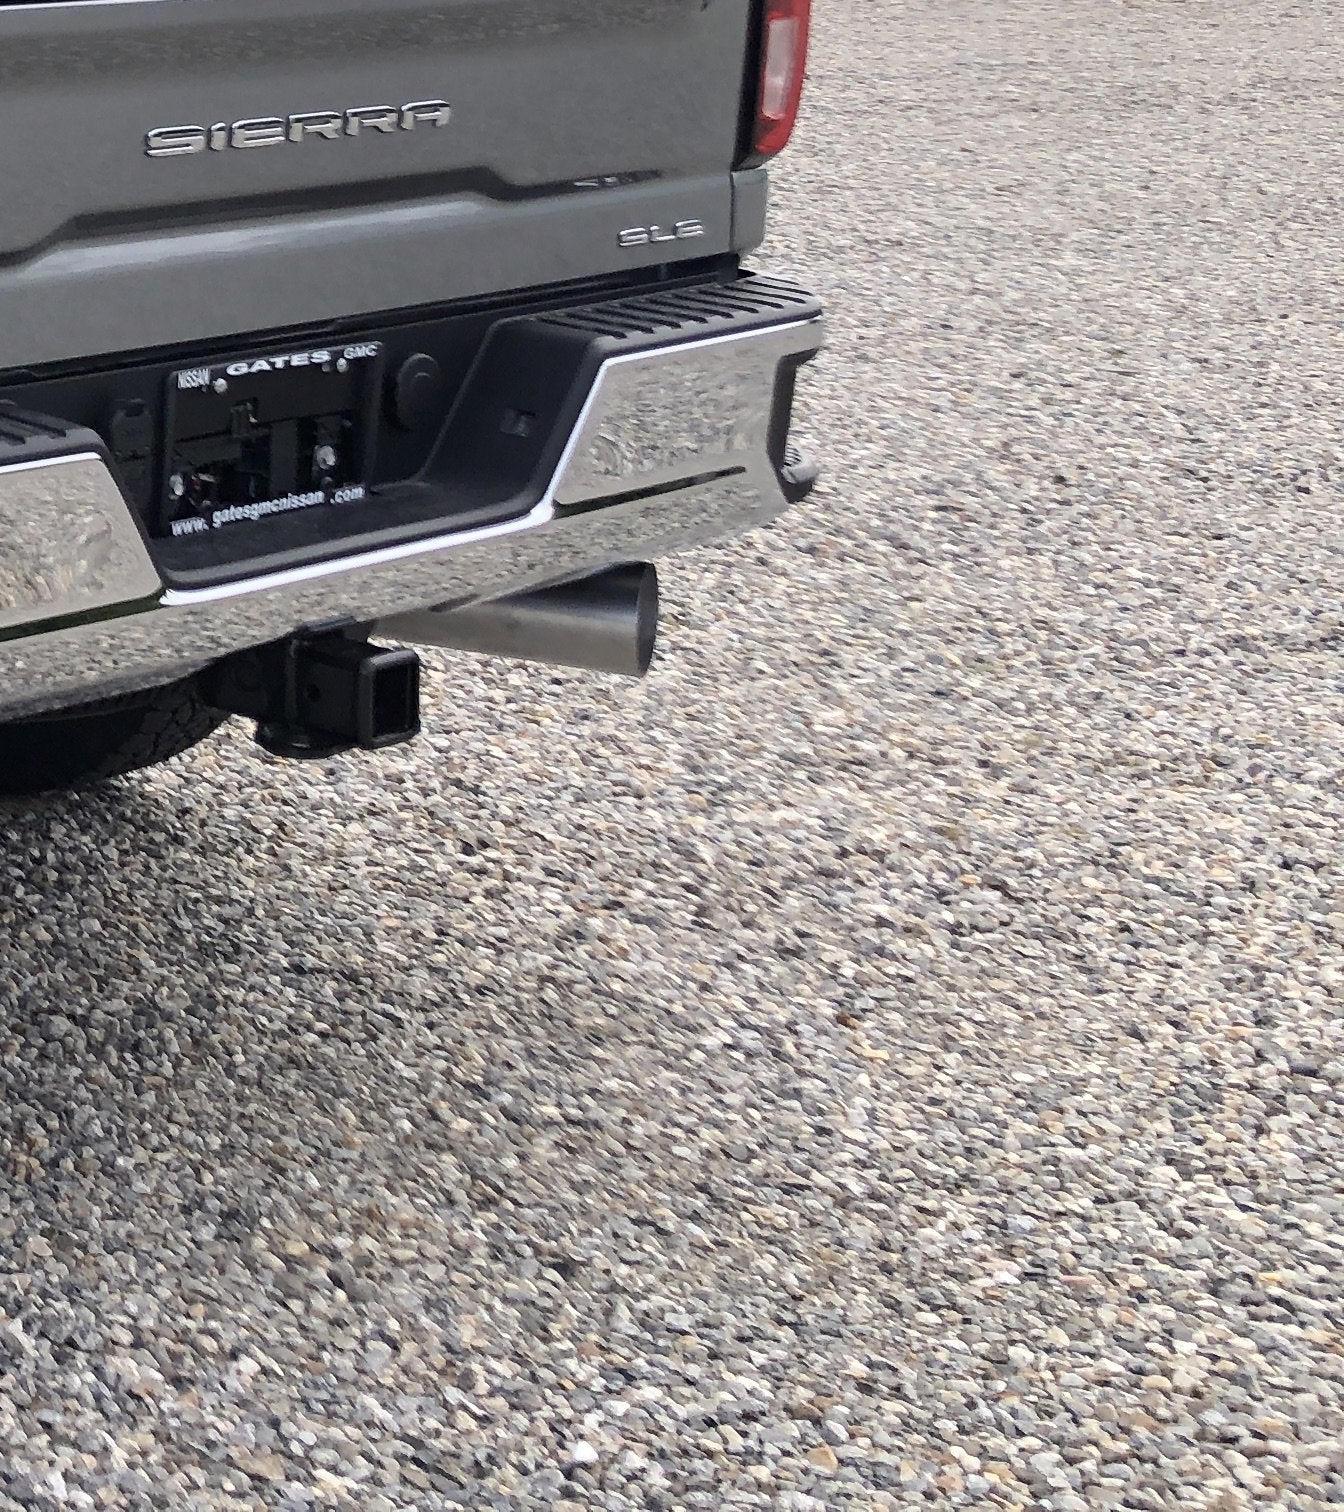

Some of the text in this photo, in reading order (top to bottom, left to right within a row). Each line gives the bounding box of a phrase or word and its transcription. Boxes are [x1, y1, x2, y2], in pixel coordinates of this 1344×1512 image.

[144, 99, 452, 157] SIERRA
[617, 219, 704, 247] SLE
[226, 350, 331, 376] GATES
[343, 345, 378, 361] GMC
